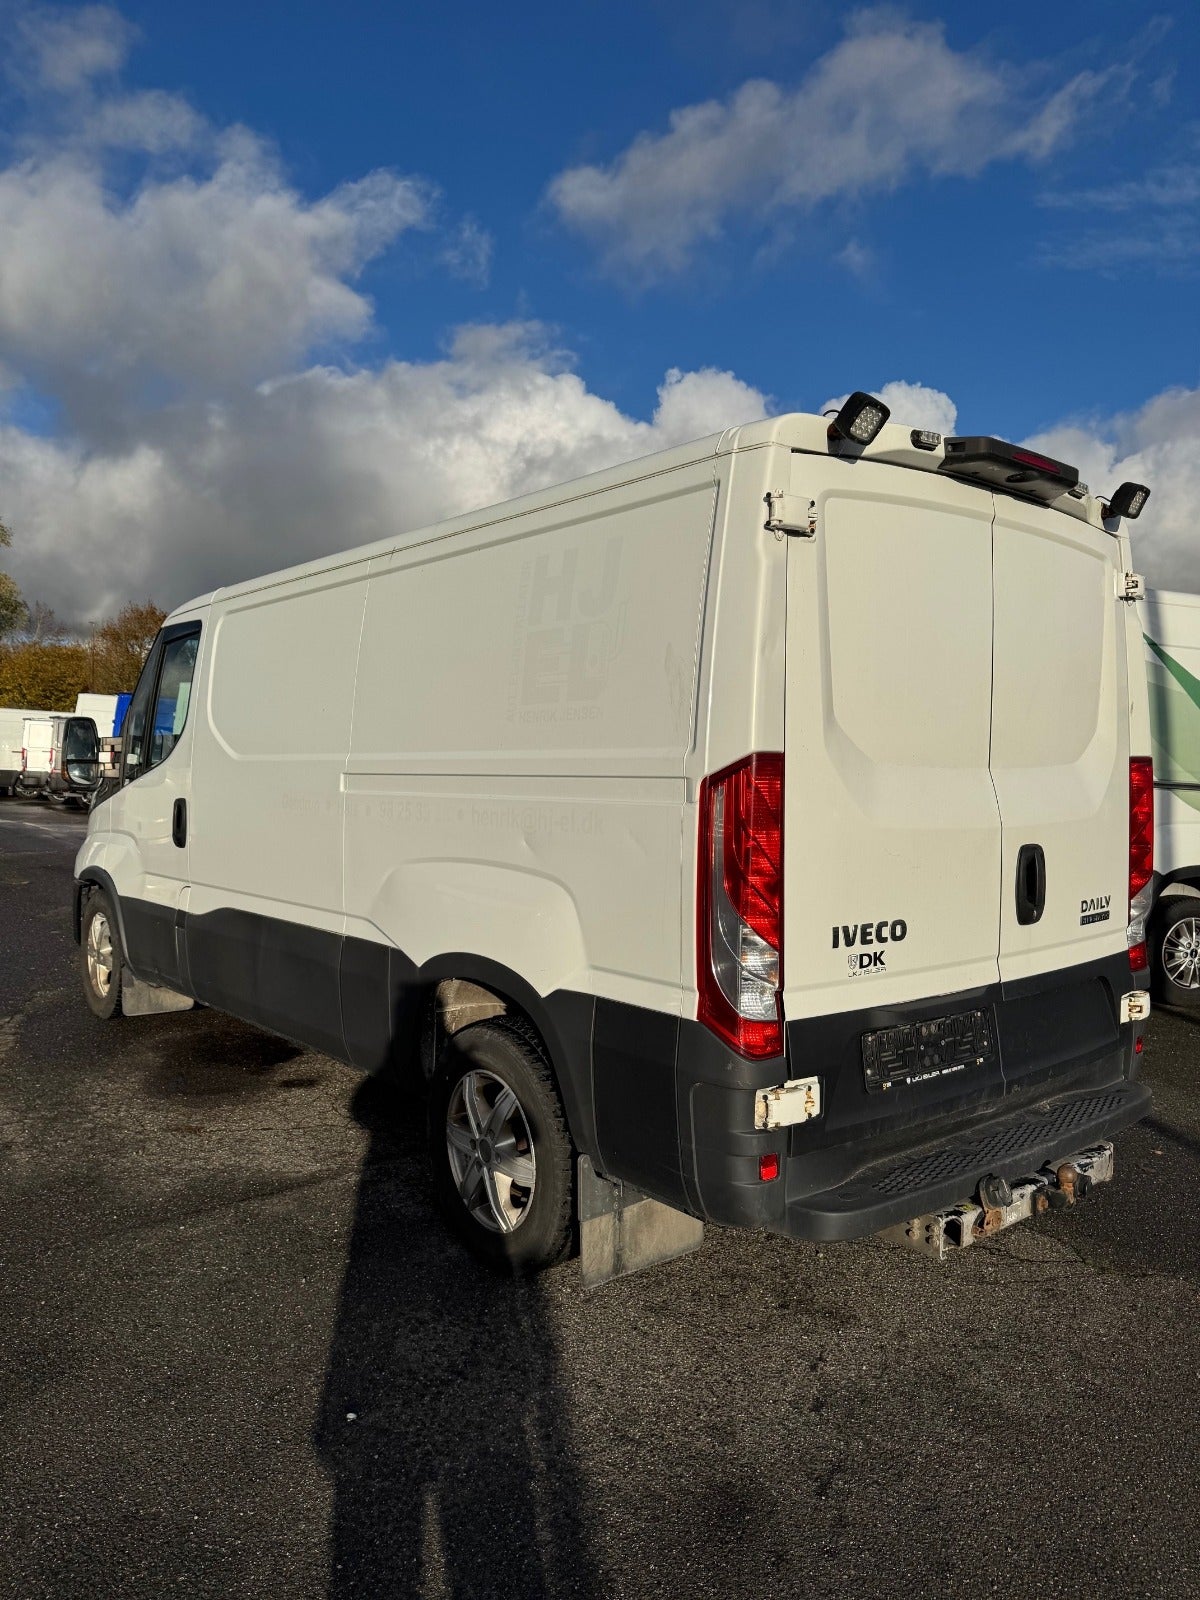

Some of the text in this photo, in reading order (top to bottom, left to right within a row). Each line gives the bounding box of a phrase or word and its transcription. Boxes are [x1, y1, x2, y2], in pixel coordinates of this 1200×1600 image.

[1081, 895, 1111, 913] DAILY
[832, 919, 907, 949] IVECO
[859, 950, 885, 969] DK
